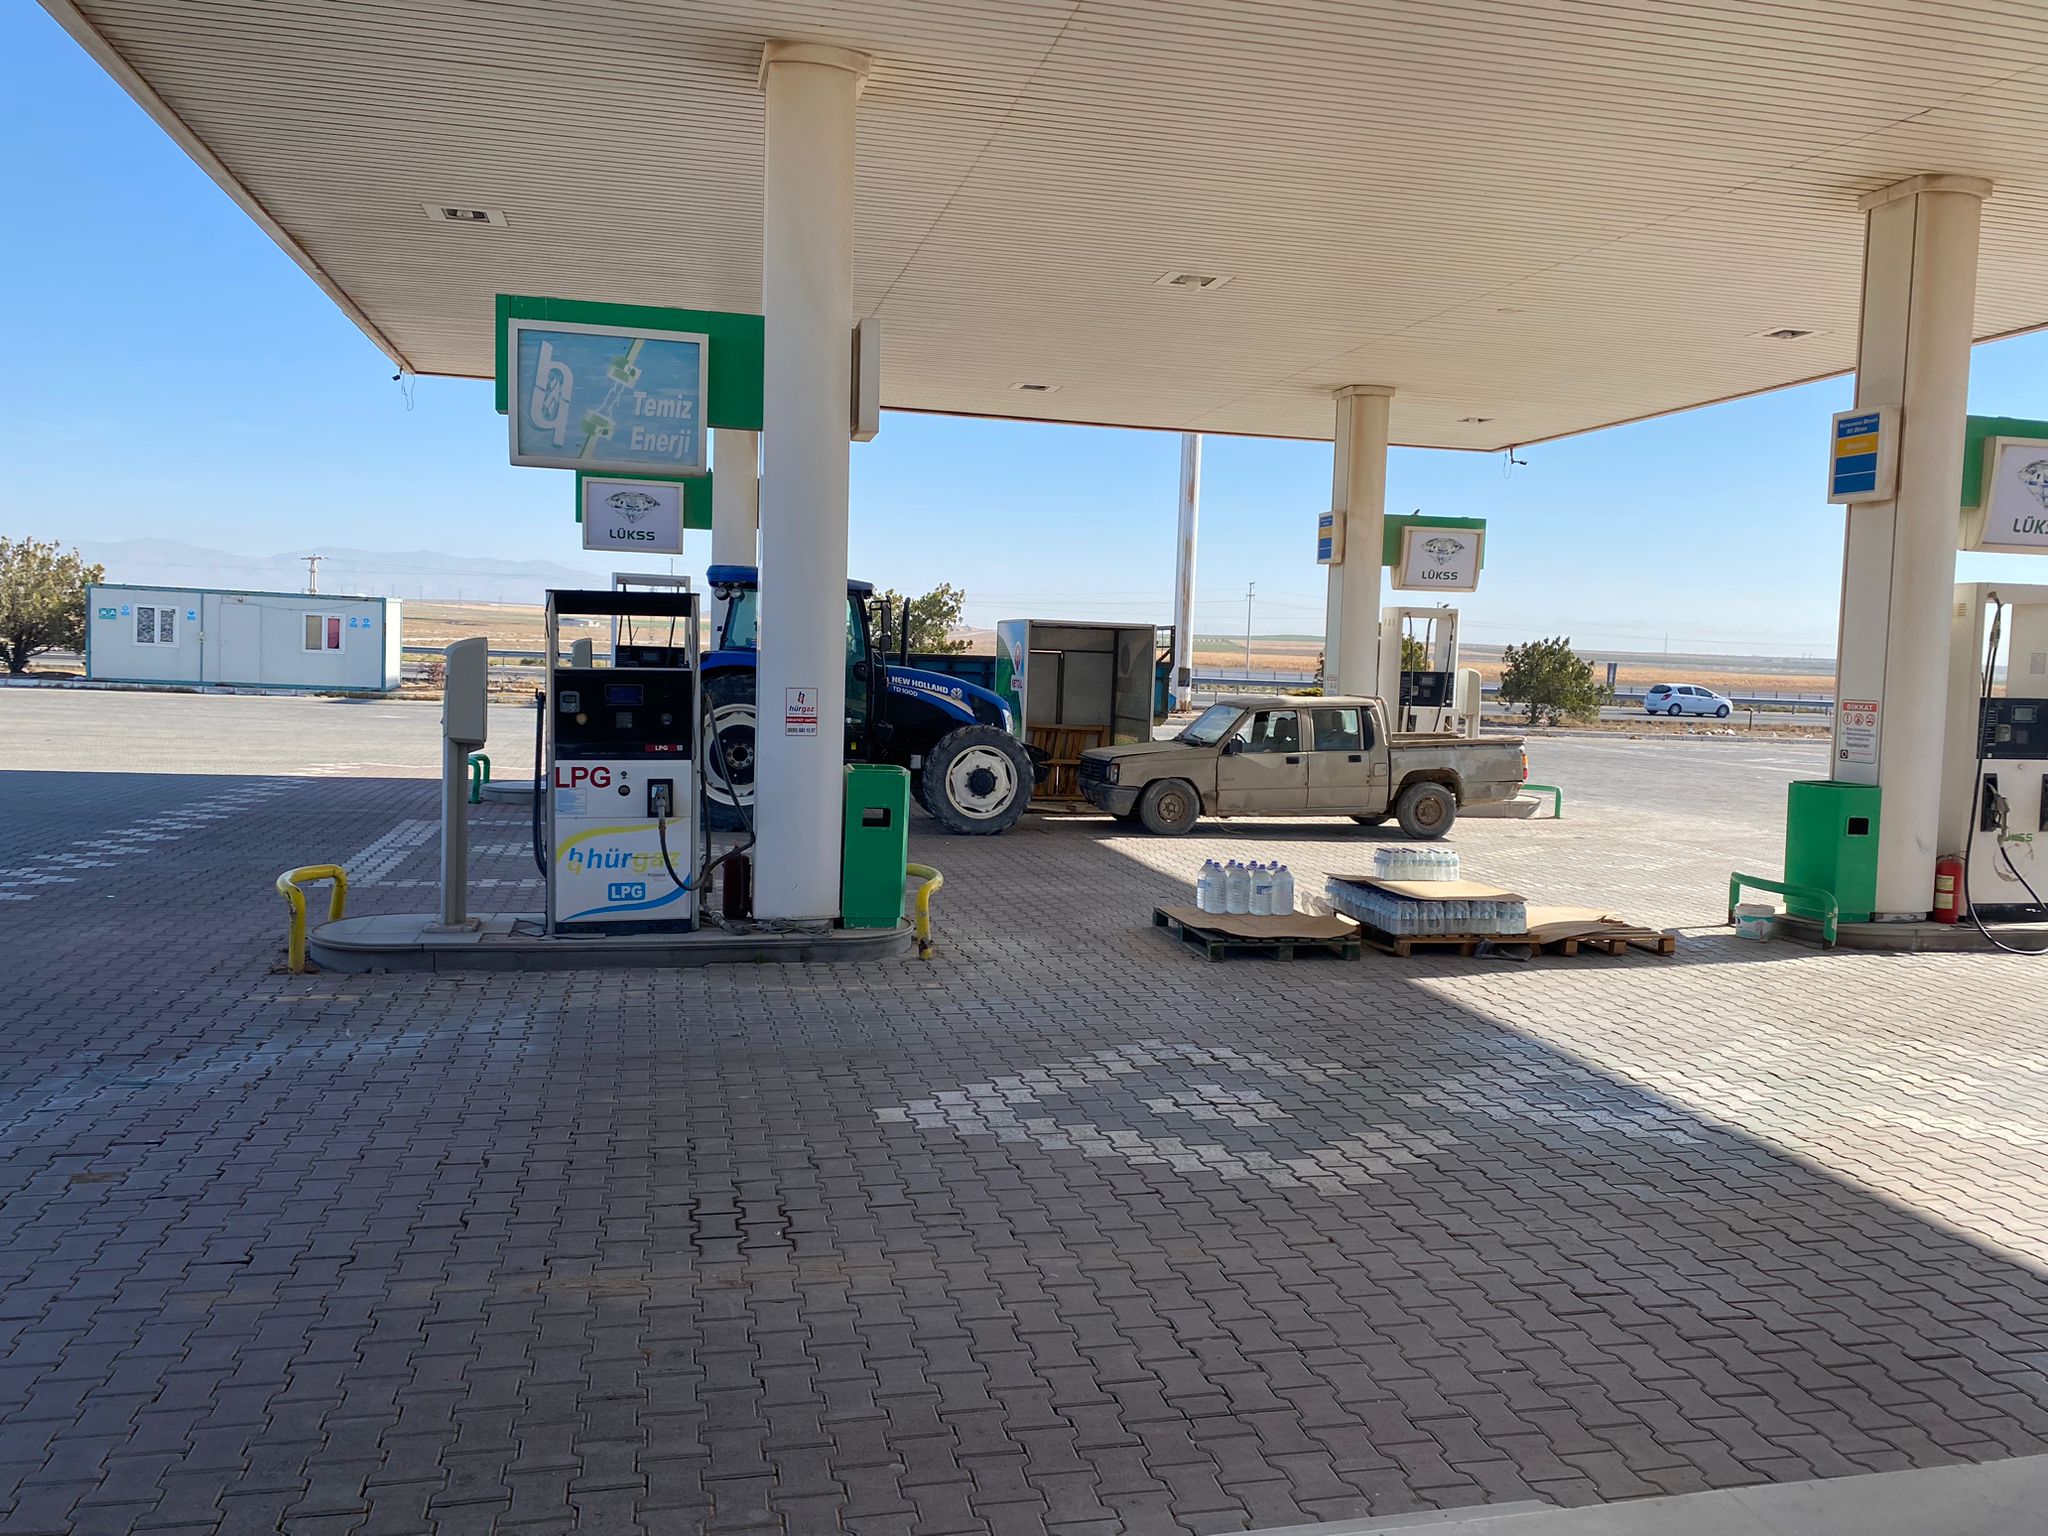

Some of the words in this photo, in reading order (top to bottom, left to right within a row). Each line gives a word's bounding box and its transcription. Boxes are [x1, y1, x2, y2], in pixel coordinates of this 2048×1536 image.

[633, 391, 693, 420] Temiz
[630, 426, 692, 459] Enerji
[609, 527, 656, 541] LÜKSS
[2012, 515, 2048, 535] LÜK
[1421, 568, 1459, 580] LÜKSS
[891, 675, 911, 686] NEW
[911, 679, 949, 694] HOLLAND
[789, 705, 815, 713] hürgaz
[555, 766, 611, 788] LPG
[586, 847, 681, 874] hürgaz
[611, 885, 643, 899] LPG
